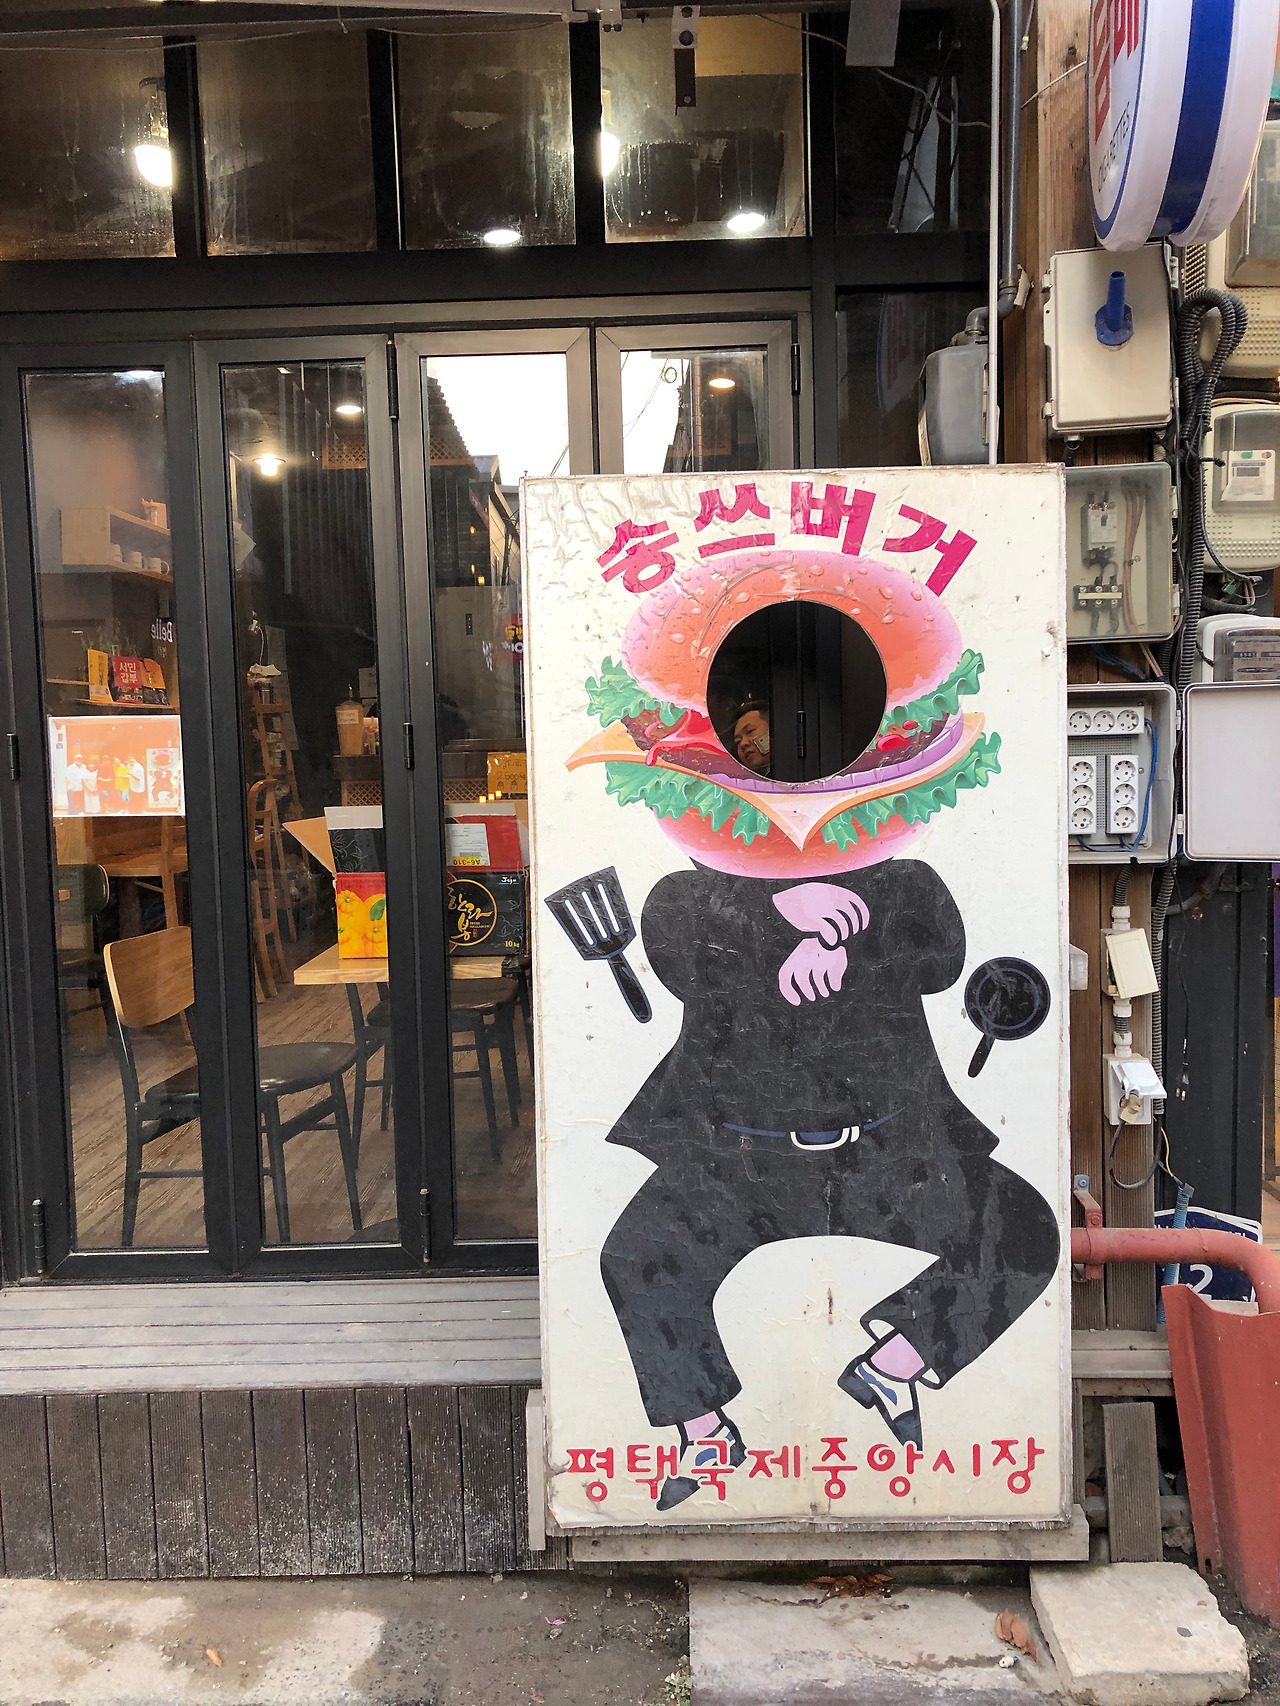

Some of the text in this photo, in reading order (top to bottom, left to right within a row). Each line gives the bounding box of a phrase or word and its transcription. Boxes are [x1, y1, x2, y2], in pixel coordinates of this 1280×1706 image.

[1098, 101, 1130, 192] CIGARETTES
[597, 481, 978, 598] 송쓰버거
[119, 662, 137, 673] 서민
[120, 672, 138, 684] 갑부
[501, 875, 518, 886] Jeju
[1188, 1264, 1213, 1301] 2
